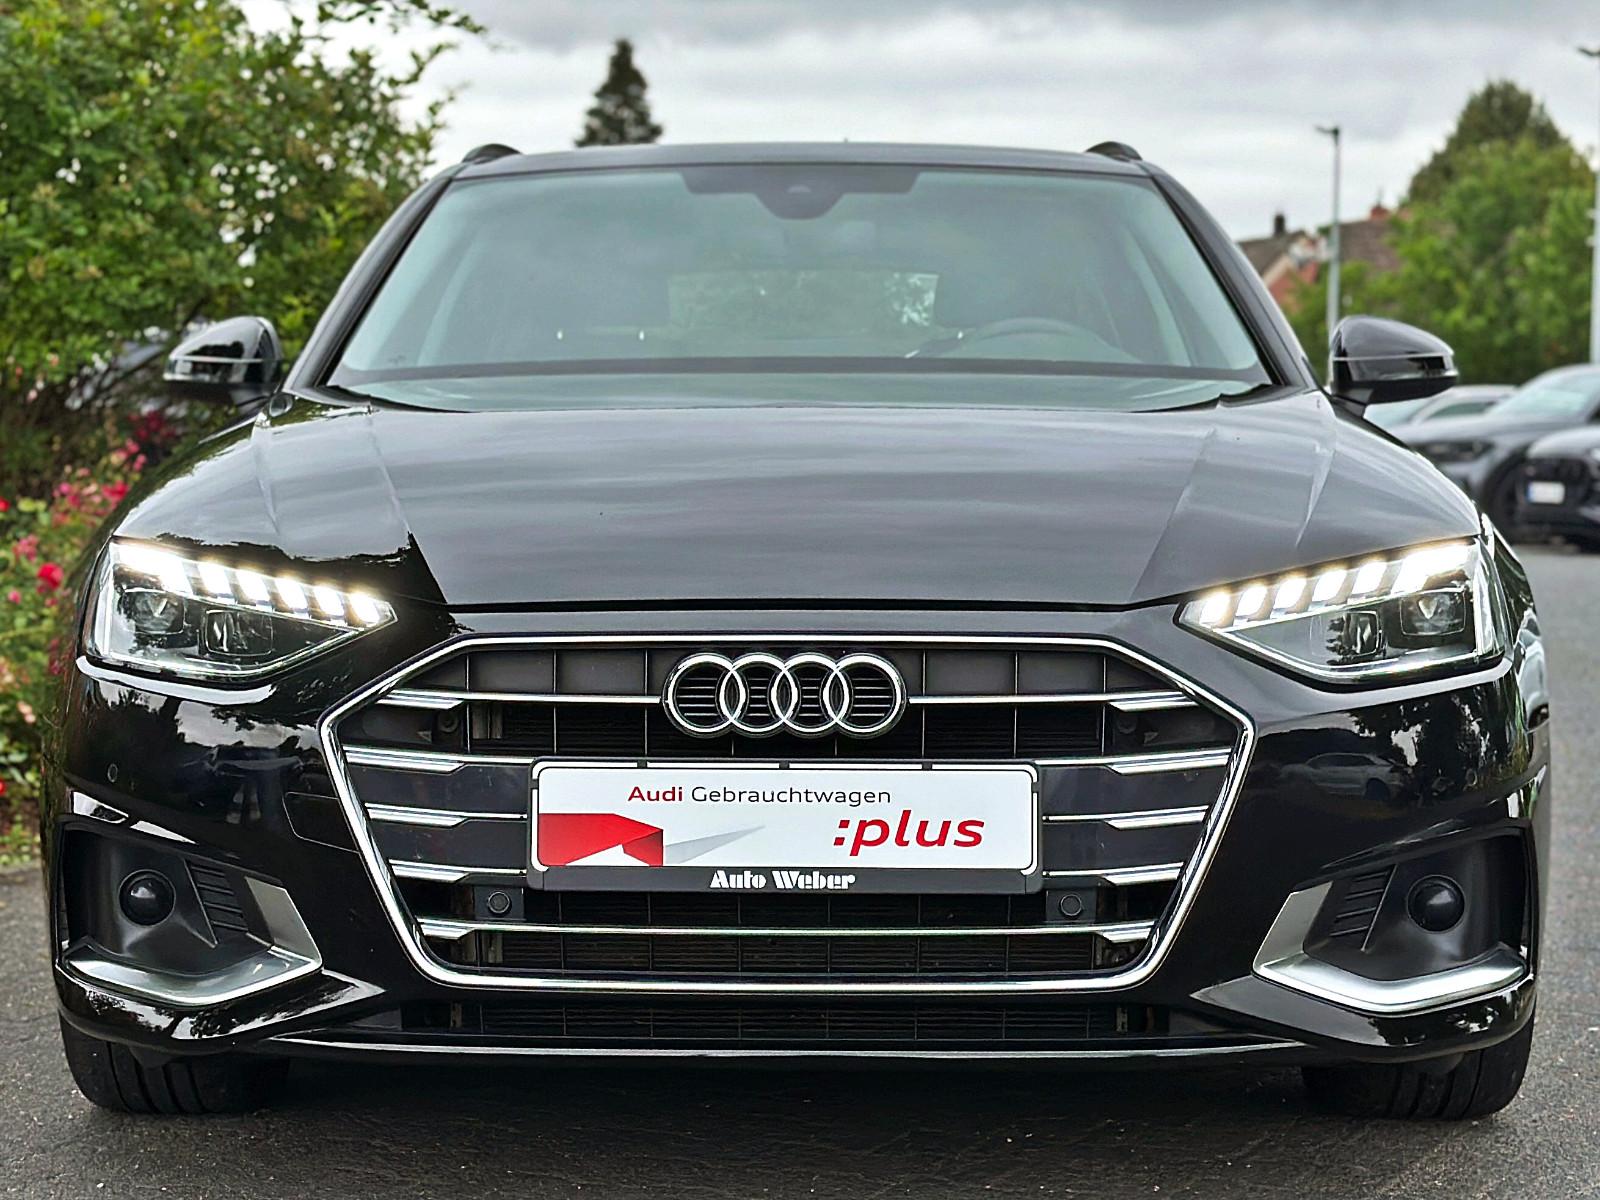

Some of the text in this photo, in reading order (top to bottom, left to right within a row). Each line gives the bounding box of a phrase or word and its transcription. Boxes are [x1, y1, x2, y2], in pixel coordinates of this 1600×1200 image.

[628, 786, 891, 807] Audi Gebrauchtwagen
[709, 869, 856, 890] Auto Weber
